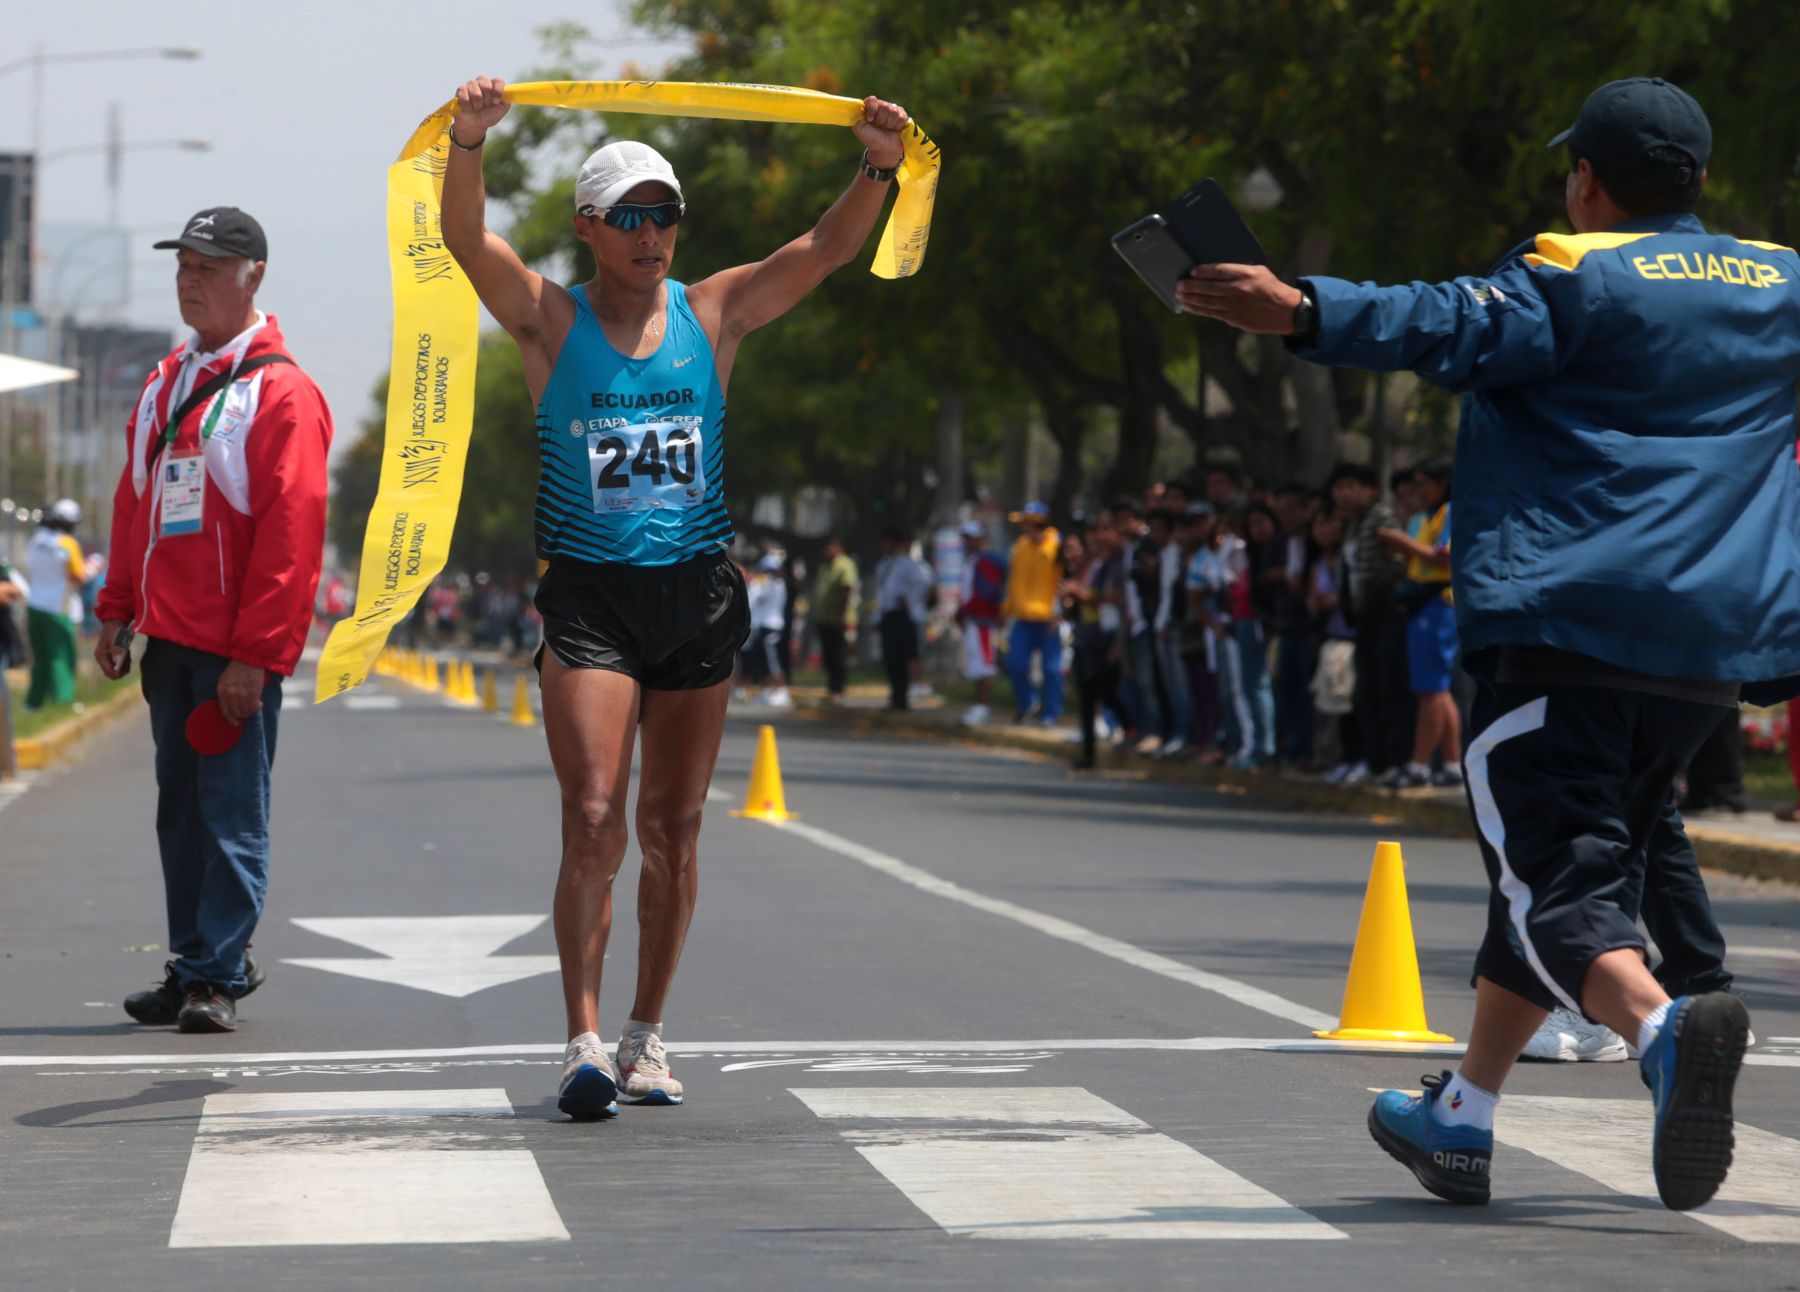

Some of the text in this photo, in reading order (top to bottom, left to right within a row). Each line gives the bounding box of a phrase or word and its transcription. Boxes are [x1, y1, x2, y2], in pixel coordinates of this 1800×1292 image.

[1633, 252, 1788, 288] ECUADOR
[413, 333, 432, 402] DEPORTIVOS
[432, 356, 450, 423] BOLIVARIANOS
[591, 388, 694, 409] ECUADOR
[411, 402, 427, 438] JUEGOS
[588, 415, 628, 431] ETAPA
[595, 429, 696, 489] 240
[383, 549, 402, 591] JUEGOS
[1433, 1151, 1489, 1176] AIRM
